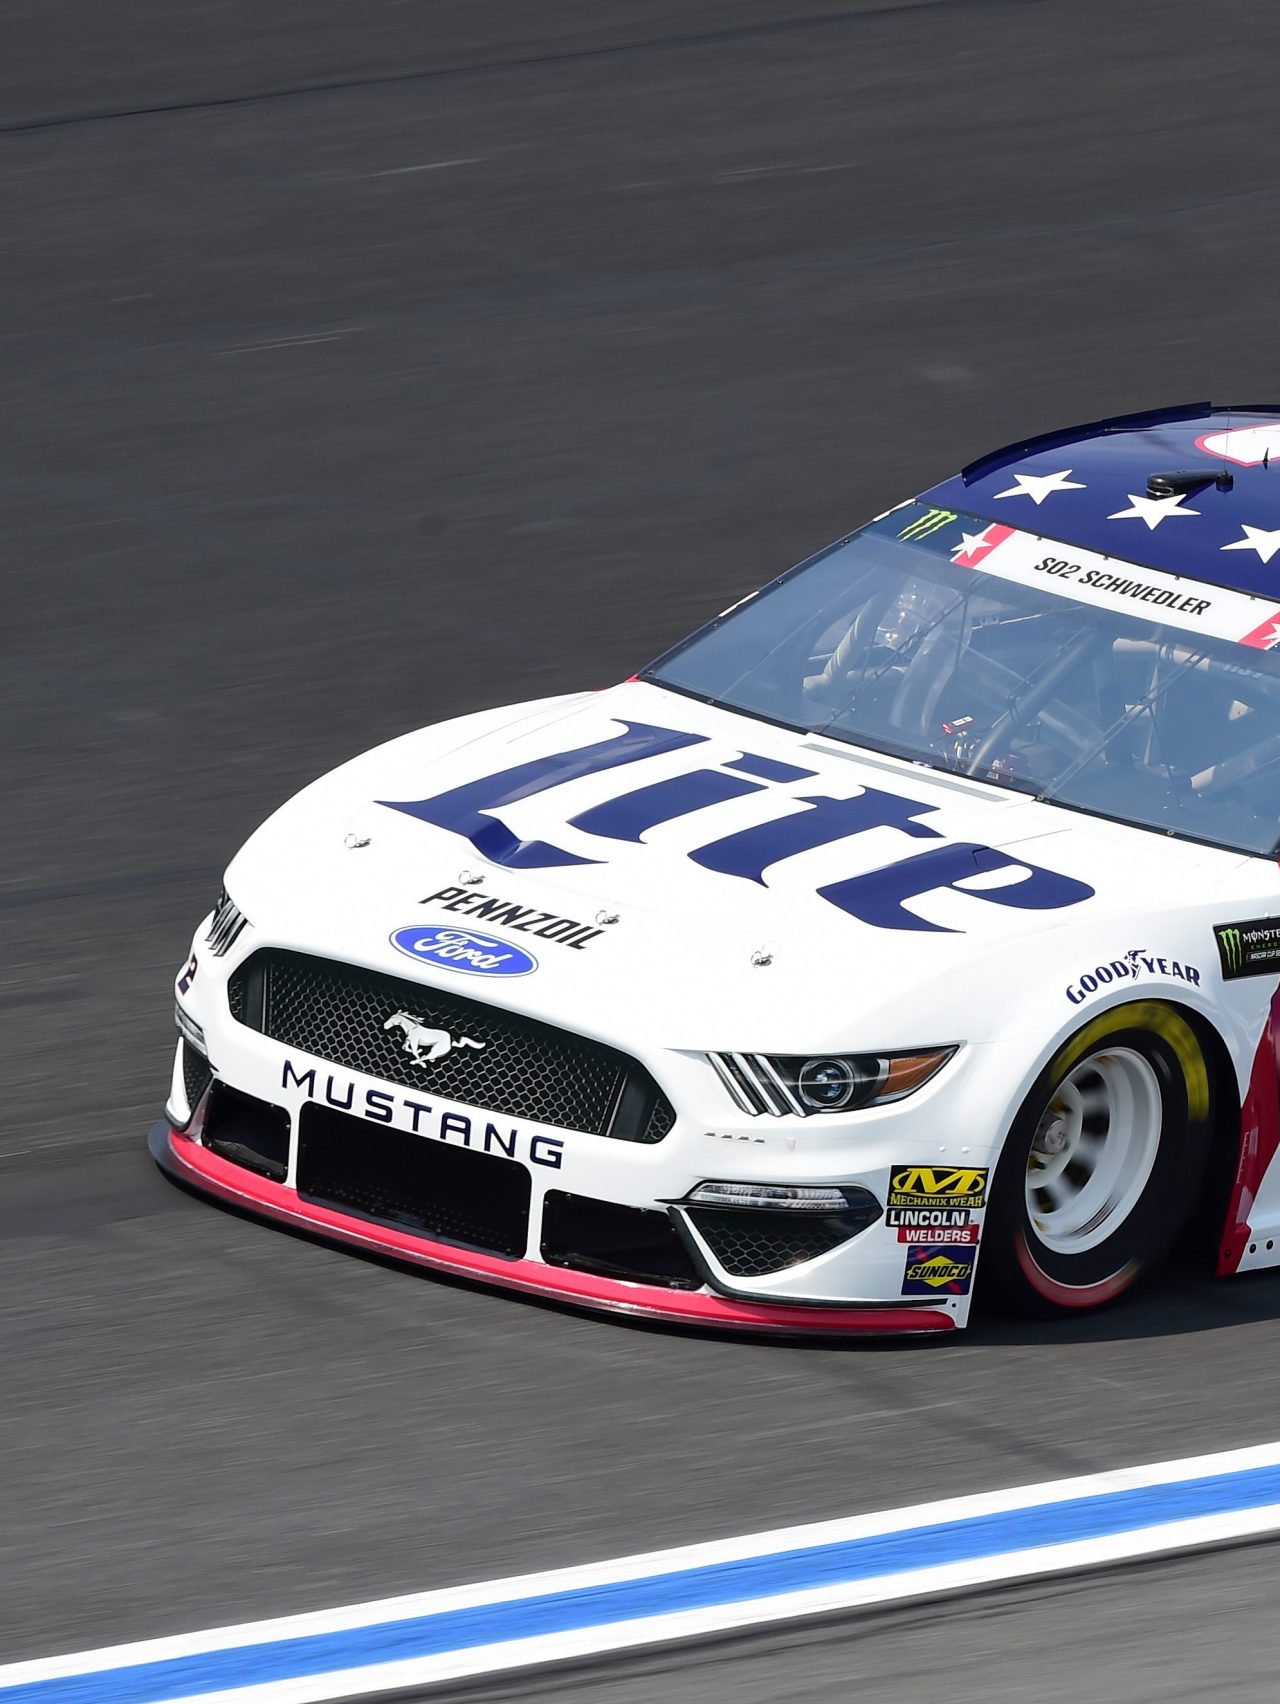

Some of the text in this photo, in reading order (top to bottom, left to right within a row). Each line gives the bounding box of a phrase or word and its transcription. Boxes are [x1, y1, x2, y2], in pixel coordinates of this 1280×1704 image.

[1078, 570, 1212, 616] SCHWEDLER
[417, 886, 606, 950] PENNZOIL
[413, 930, 514, 970] Ford
[281, 1060, 565, 1169] MUSTANG
[890, 1193, 982, 1207] MECHANIX WEAR
[890, 1210, 966, 1227] LINCOLN
[905, 1230, 971, 1243] WELDERS
[909, 1264, 970, 1279] SUNOCO
